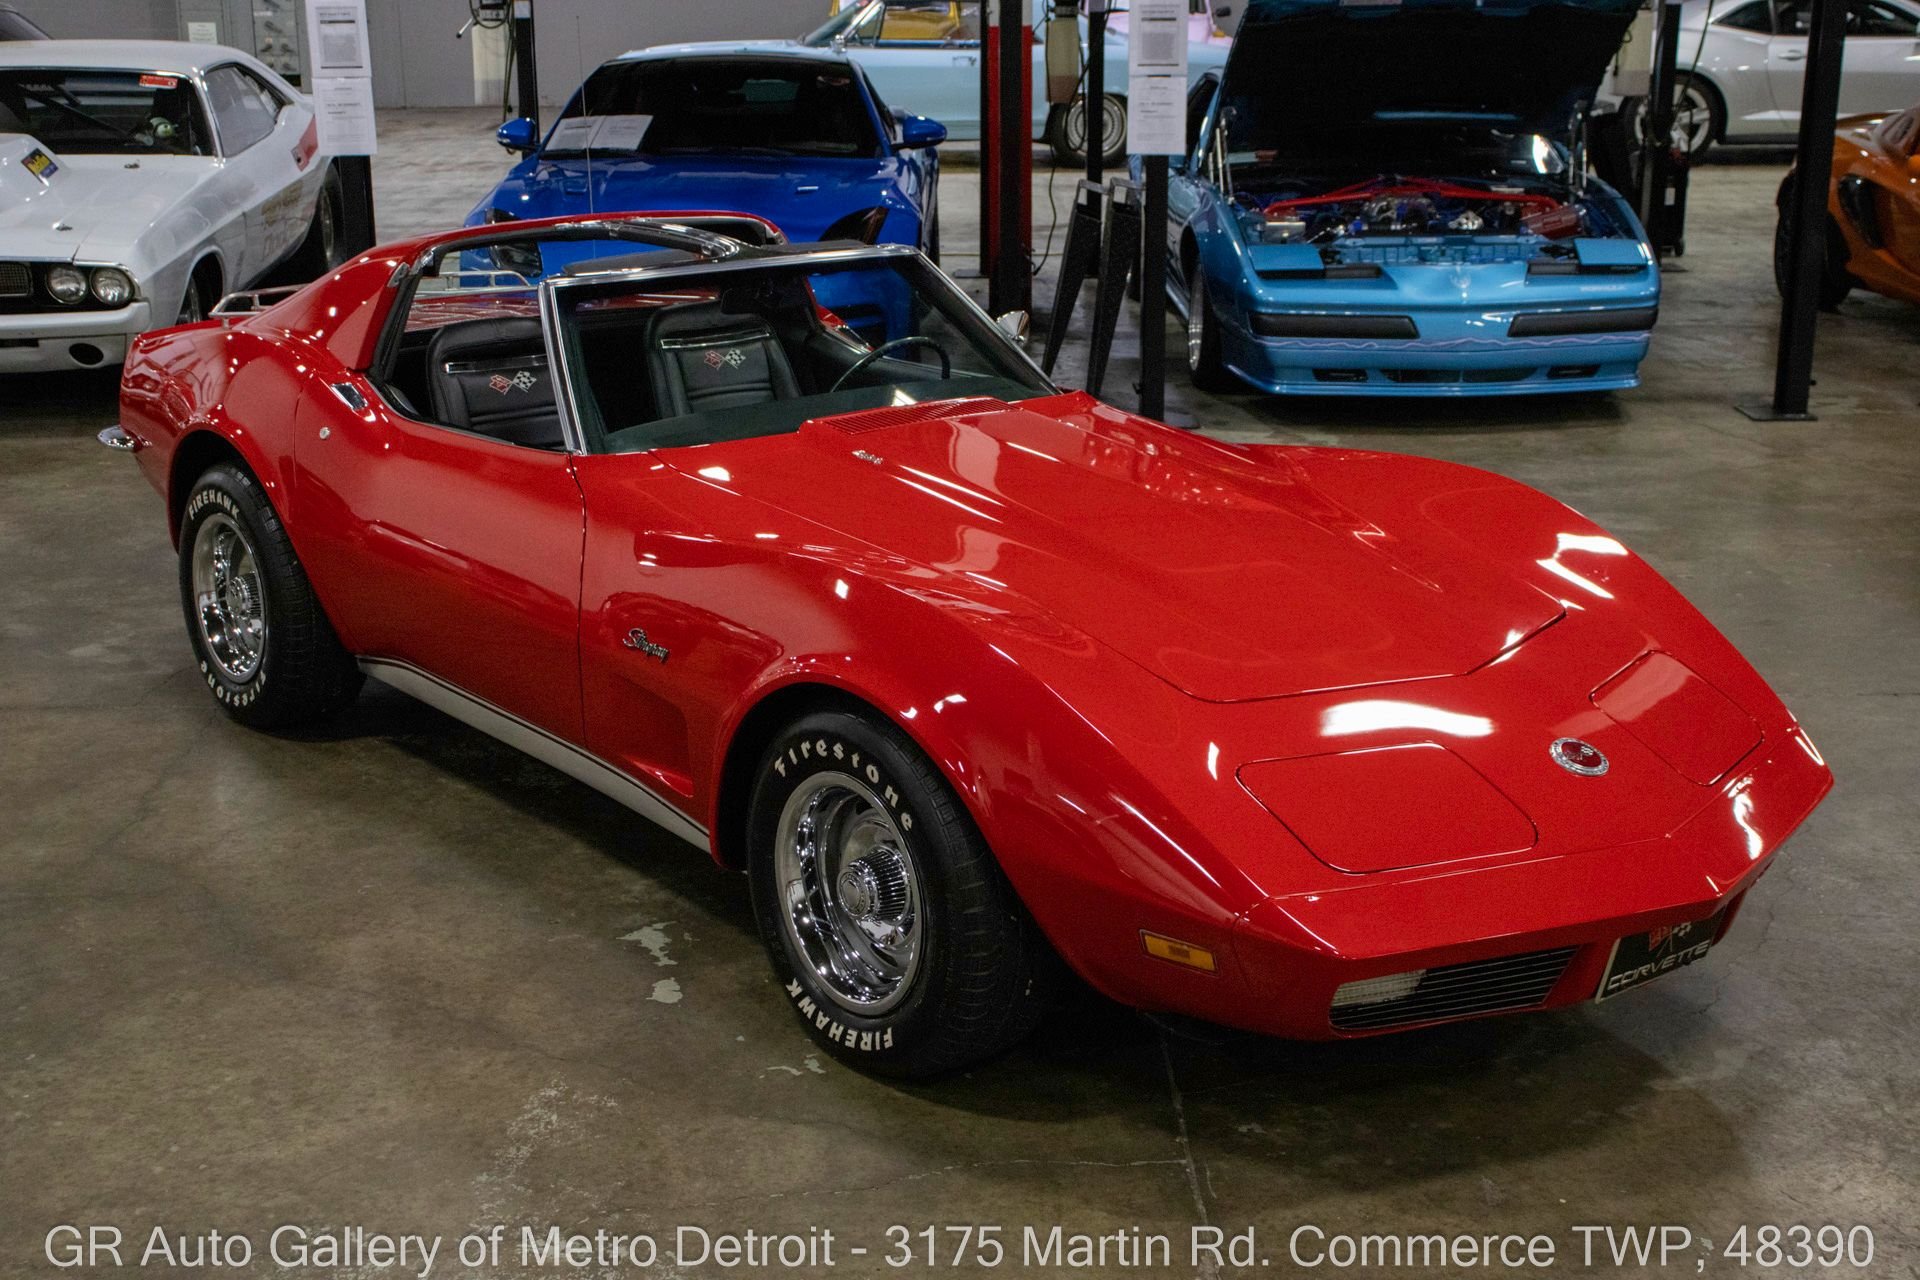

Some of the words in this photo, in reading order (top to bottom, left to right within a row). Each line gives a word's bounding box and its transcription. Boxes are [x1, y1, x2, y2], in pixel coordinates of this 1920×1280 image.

[188, 488, 240, 520] FIREHAWK
[201, 662, 266, 707] Firestone
[774, 738, 913, 831] Firestone
[1607, 939, 1710, 991] CORVETTE
[785, 976, 894, 1052] FIREHAWK
